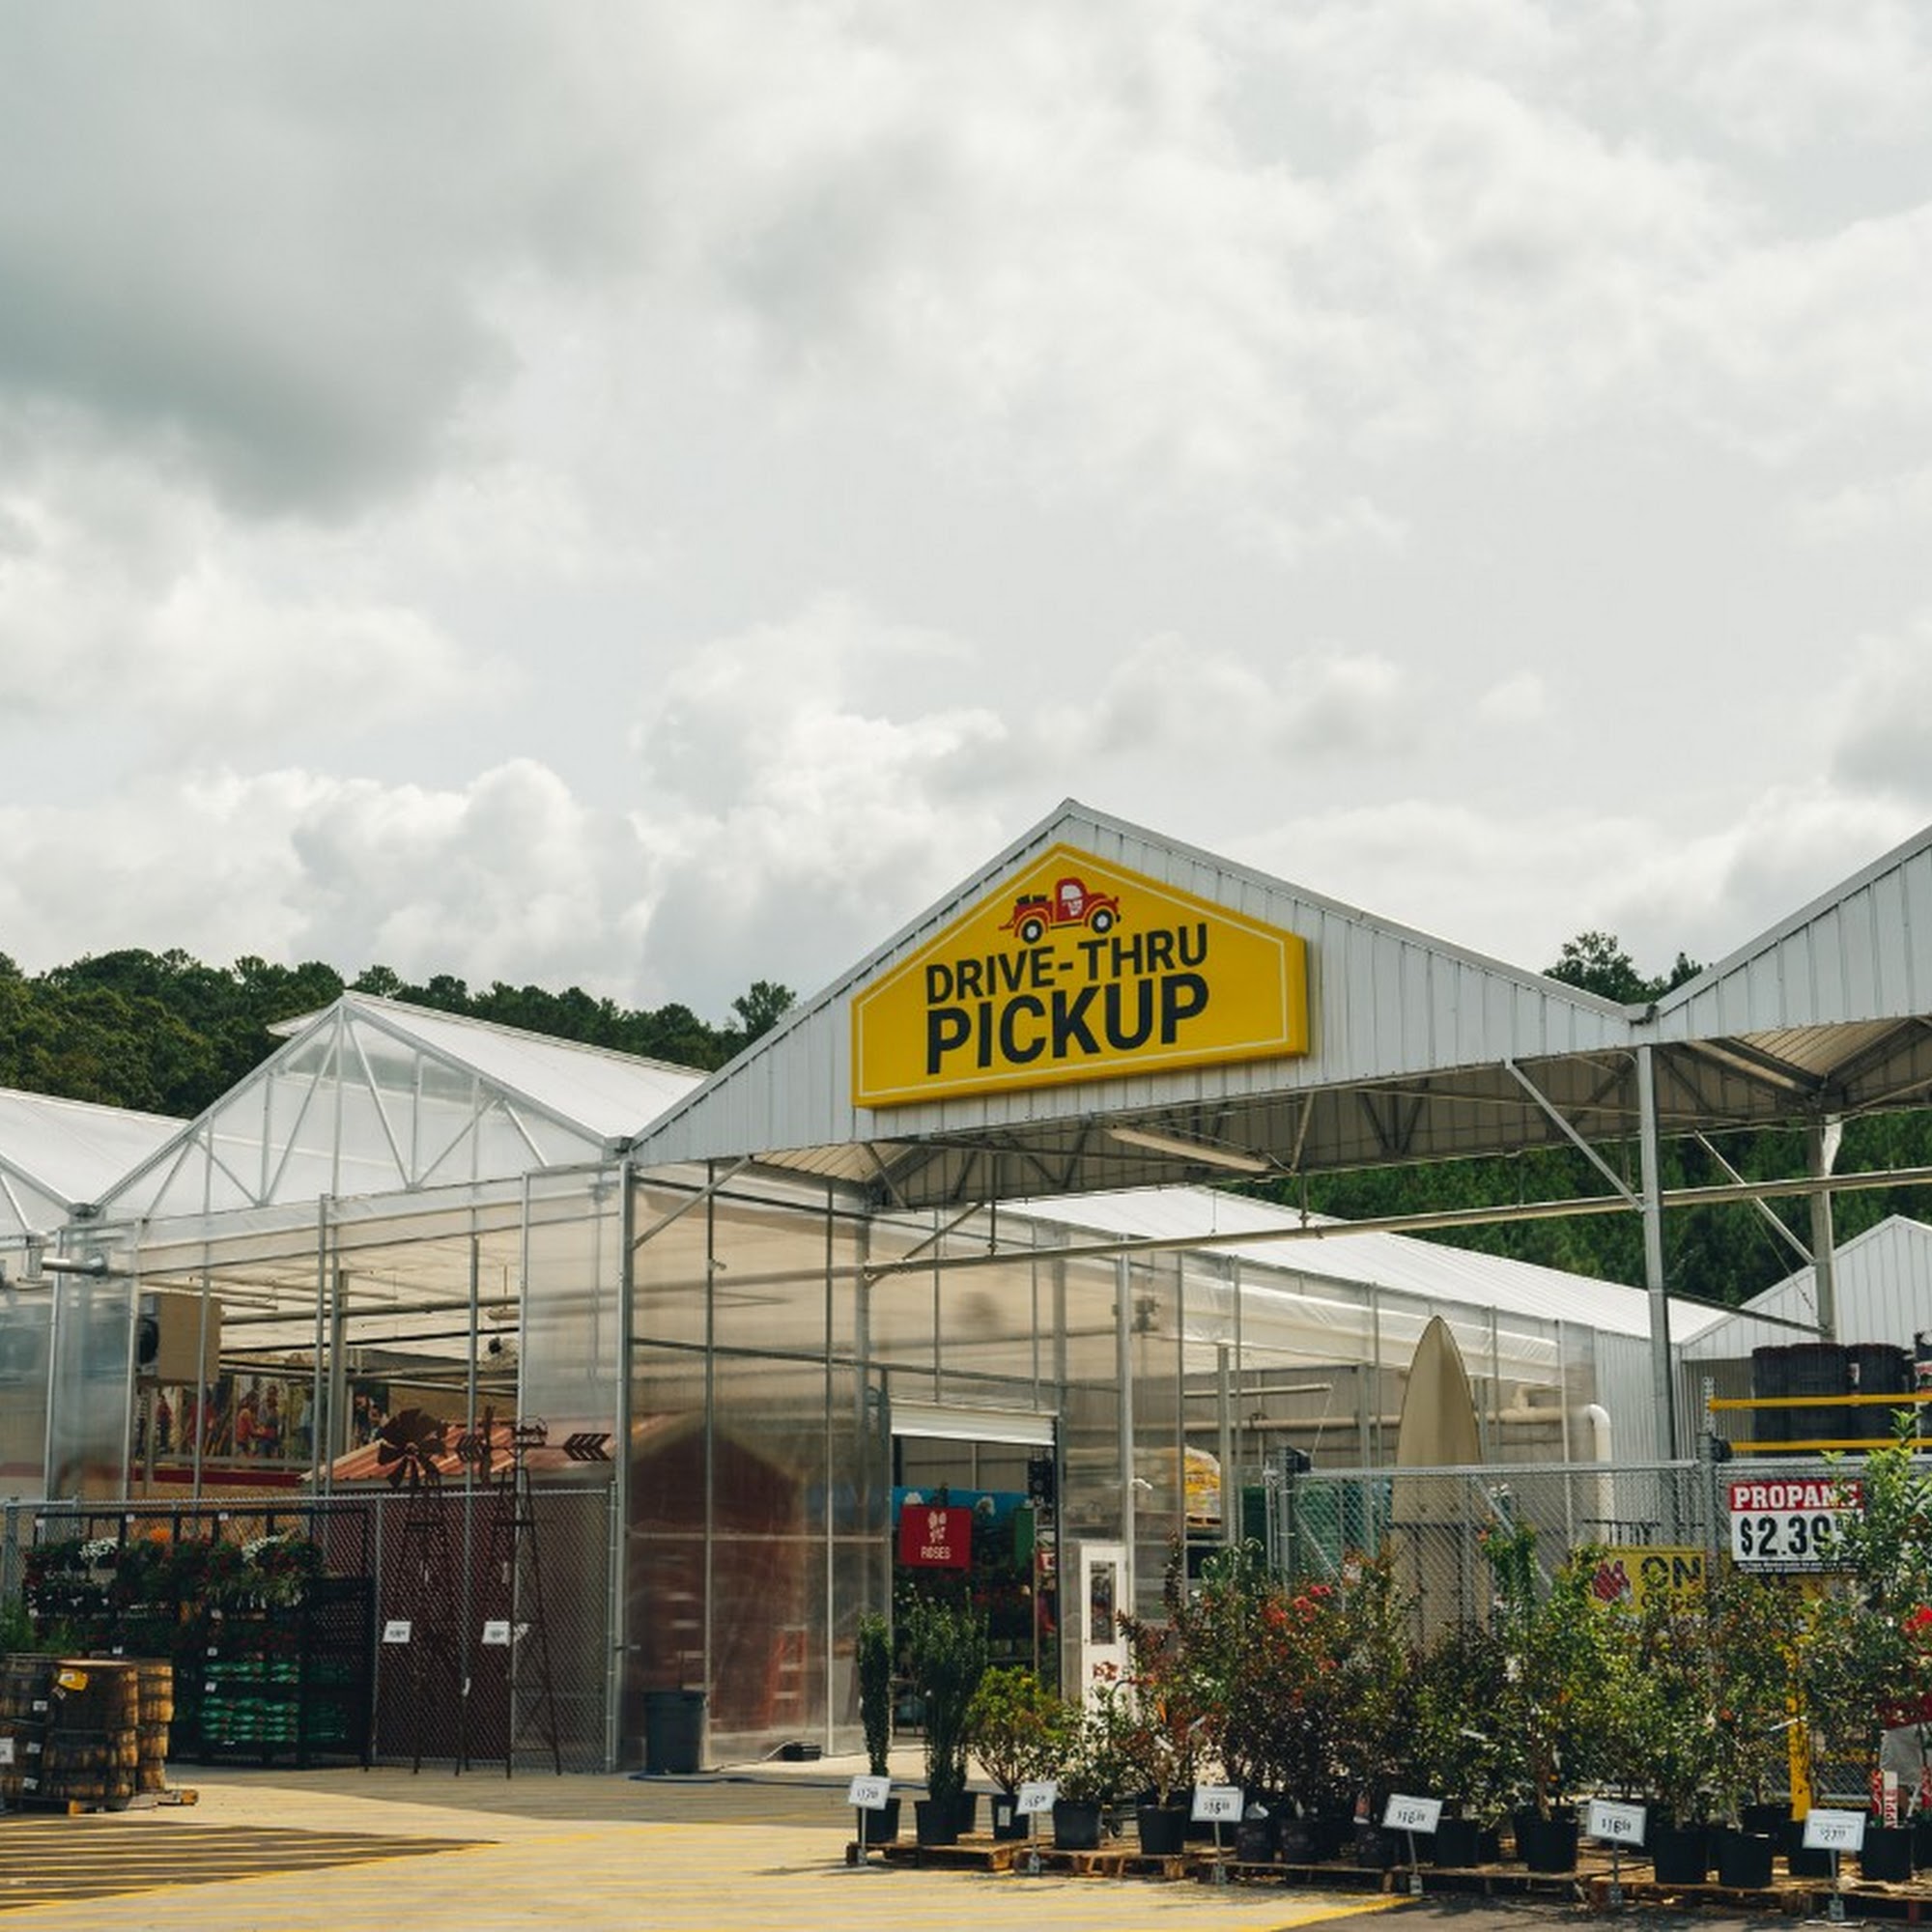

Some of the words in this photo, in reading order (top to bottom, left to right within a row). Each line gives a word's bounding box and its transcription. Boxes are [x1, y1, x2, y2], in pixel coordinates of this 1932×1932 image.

[926, 923, 1208, 1006] DRIVE-THRU
[926, 973, 1209, 1075] PICKUP
[921, 1547, 952, 1560] ROSES
